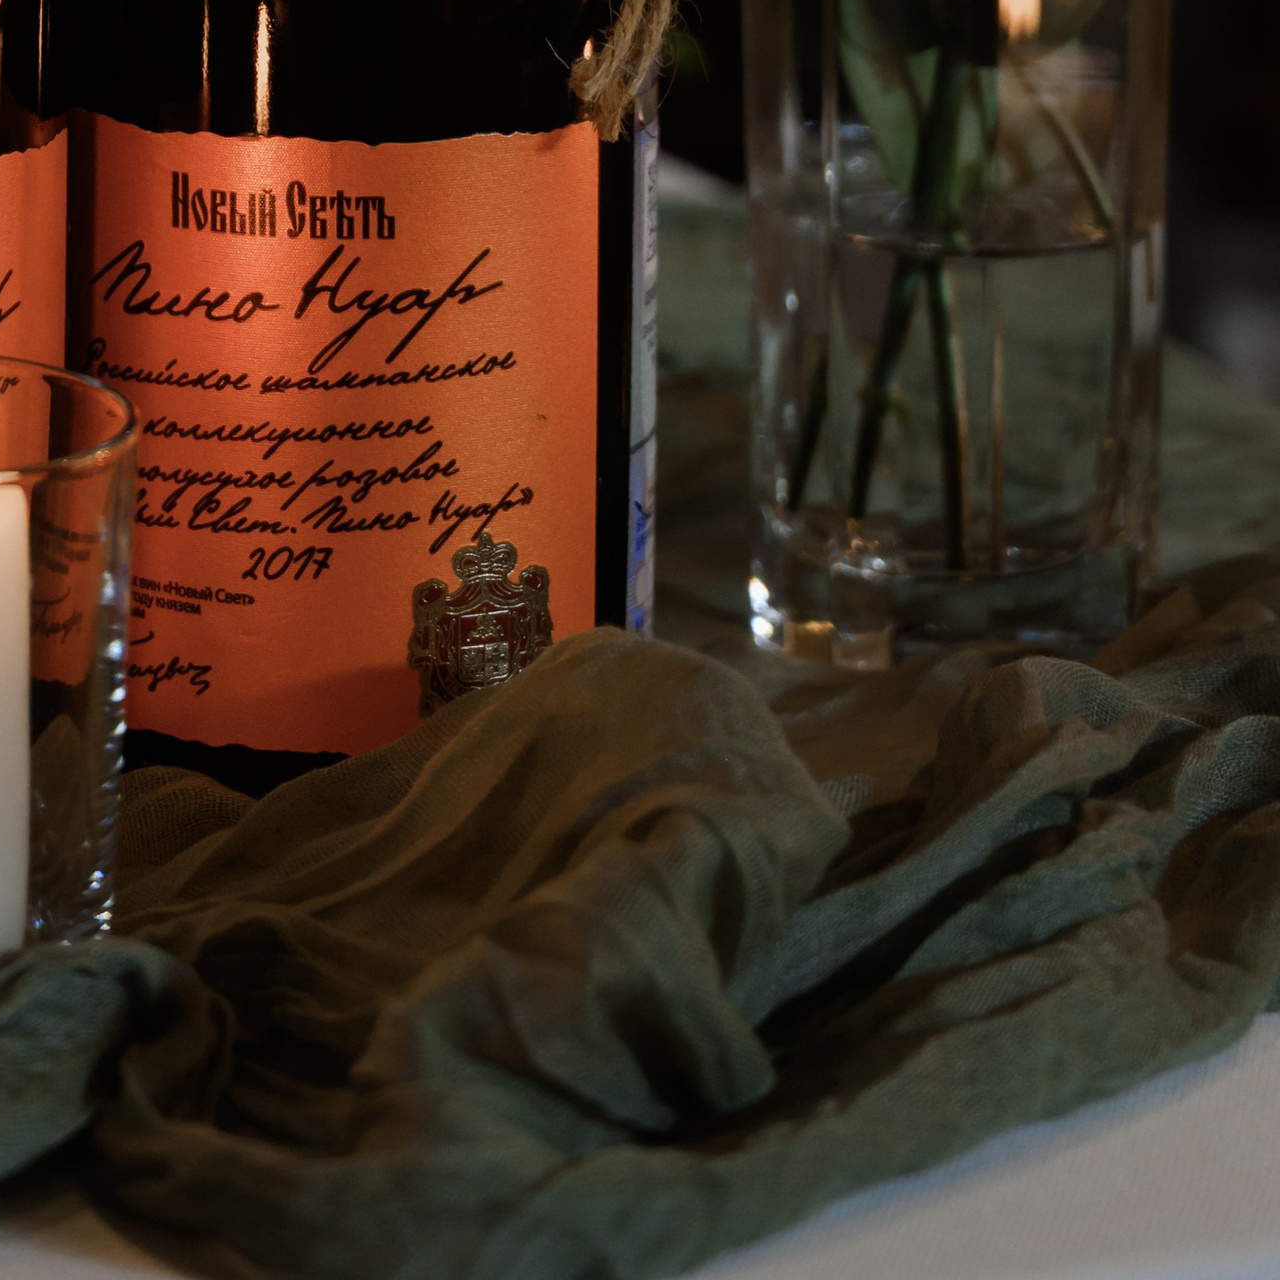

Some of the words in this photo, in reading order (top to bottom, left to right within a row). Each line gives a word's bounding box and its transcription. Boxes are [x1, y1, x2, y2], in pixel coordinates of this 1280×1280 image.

[171, 171, 276, 237] Новый
[91, 240, 280, 324] Пино
[294, 243, 504, 372] Нуар
[82, 338, 251, 391] Российское
[259, 350, 517, 394] шампанское
[143, 414, 434, 461] коллекционное
[280, 440, 460, 511] розовое
[301, 496, 421, 534] Пино
[241, 545, 334, 581] 2017
[139, 577, 161, 591] вин
[163, 580, 213, 601] «Новый
[215, 588, 255, 605] Свет»
[156, 597, 202, 614] князем
